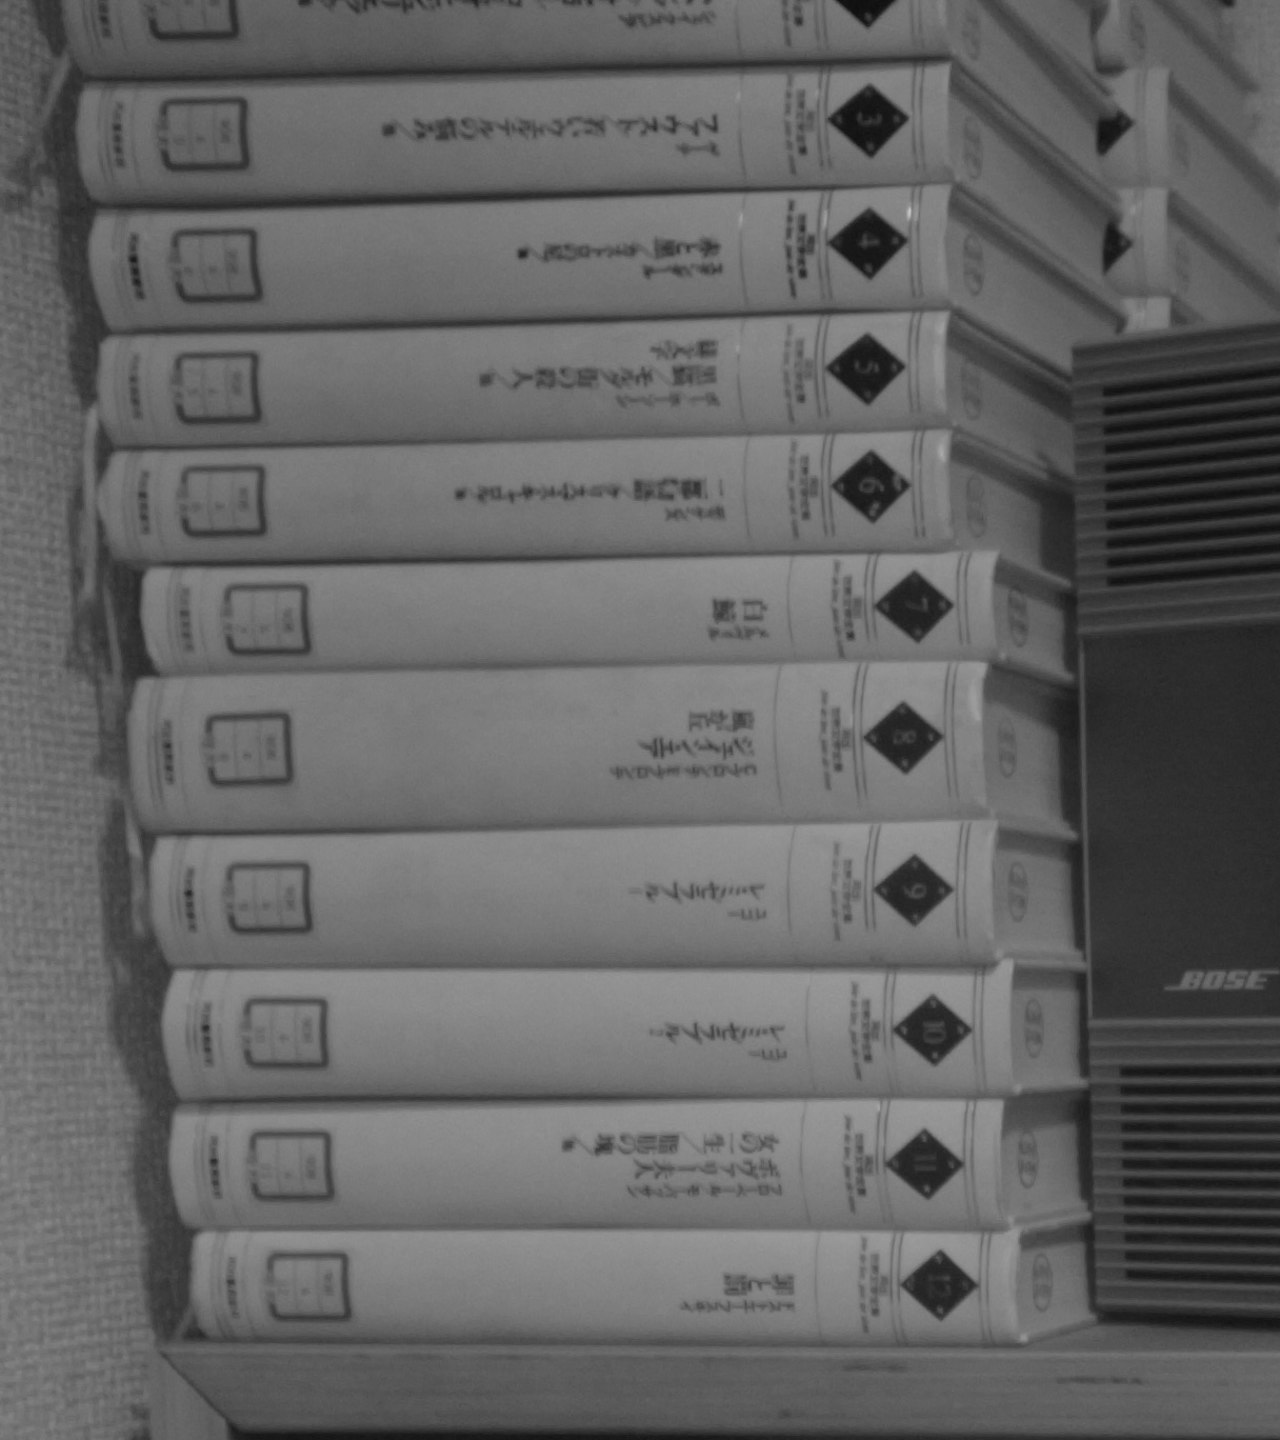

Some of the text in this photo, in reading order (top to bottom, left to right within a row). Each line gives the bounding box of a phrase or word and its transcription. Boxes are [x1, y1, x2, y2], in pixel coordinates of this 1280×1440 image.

[857, 111, 881, 127] 3
[857, 233, 880, 249] 4
[854, 360, 880, 376] 5
[858, 479, 884, 495] 6
[711, 597, 768, 622] 白鯨
[903, 594, 929, 613] 7
[688, 710, 756, 733] 嵐が丘
[892, 730, 916, 744] 8
[904, 884, 927, 899] 9
[1164, 968, 1280, 992] BOSE
[923, 1020, 946, 1044] 10
[634, 1158, 777, 1180] ボヴァリー夫人
[914, 1153, 937, 1172] 11
[723, 1272, 796, 1297] 罪と罰
[927, 1274, 952, 1298] 12
